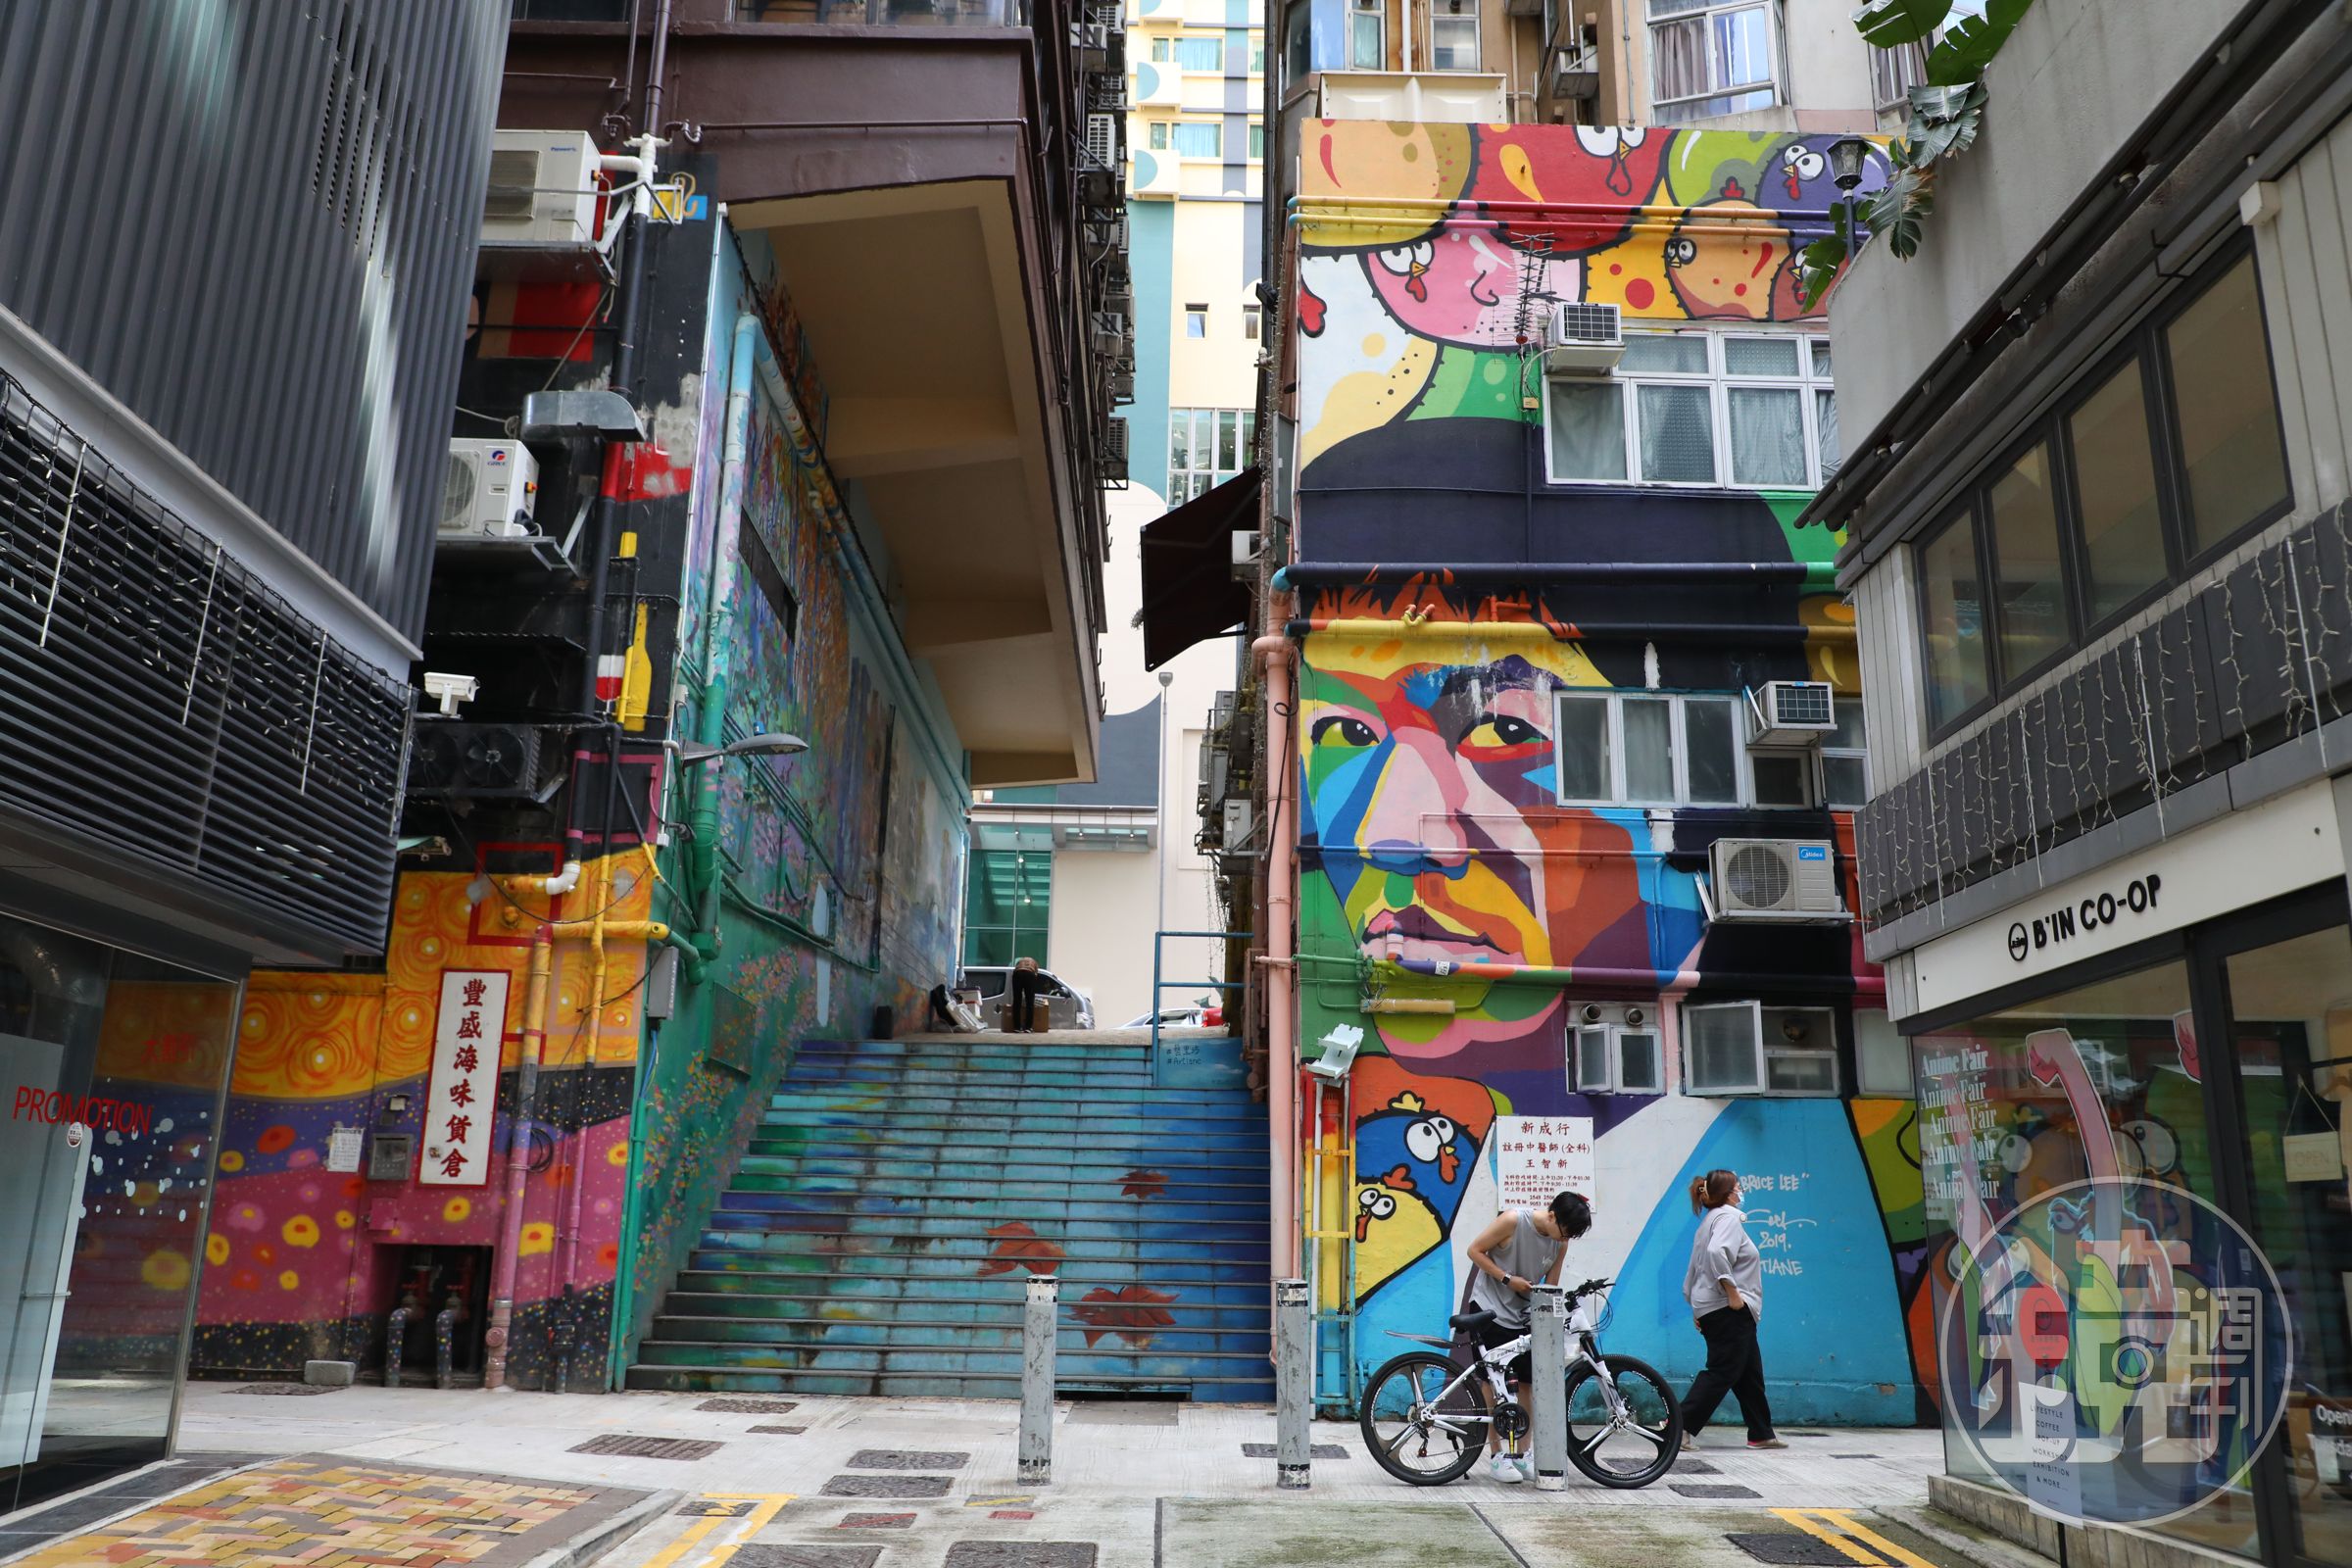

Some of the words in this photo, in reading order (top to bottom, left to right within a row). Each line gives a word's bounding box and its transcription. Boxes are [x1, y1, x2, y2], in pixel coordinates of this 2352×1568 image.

[2033, 906, 2076, 949] B'IN
[2080, 874, 2161, 930] CO-OP
[1921, 1051, 1960, 1078] Anime
[1961, 1044, 1988, 1071] Fair
[441, 978, 487, 1178] 豐盛海味貨倉
[1921, 1083, 1958, 1109] Anime
[1960, 1075, 1986, 1103] Fair
[13, 1085, 153, 1136] PROMOTION
[1930, 1107, 1968, 1136] Anime
[1970, 1102, 1997, 1130] Fair
[1521, 1121, 1570, 1136] 新成行
[1526, 1158, 1568, 1169] 王智新
[2295, 1150, 2329, 1167] OPEN
[1760, 1257, 1803, 1277] TLANE
[2035, 1419, 2060, 1432] COFFEE
[2034, 1460, 2070, 1477] EXHIBITION
